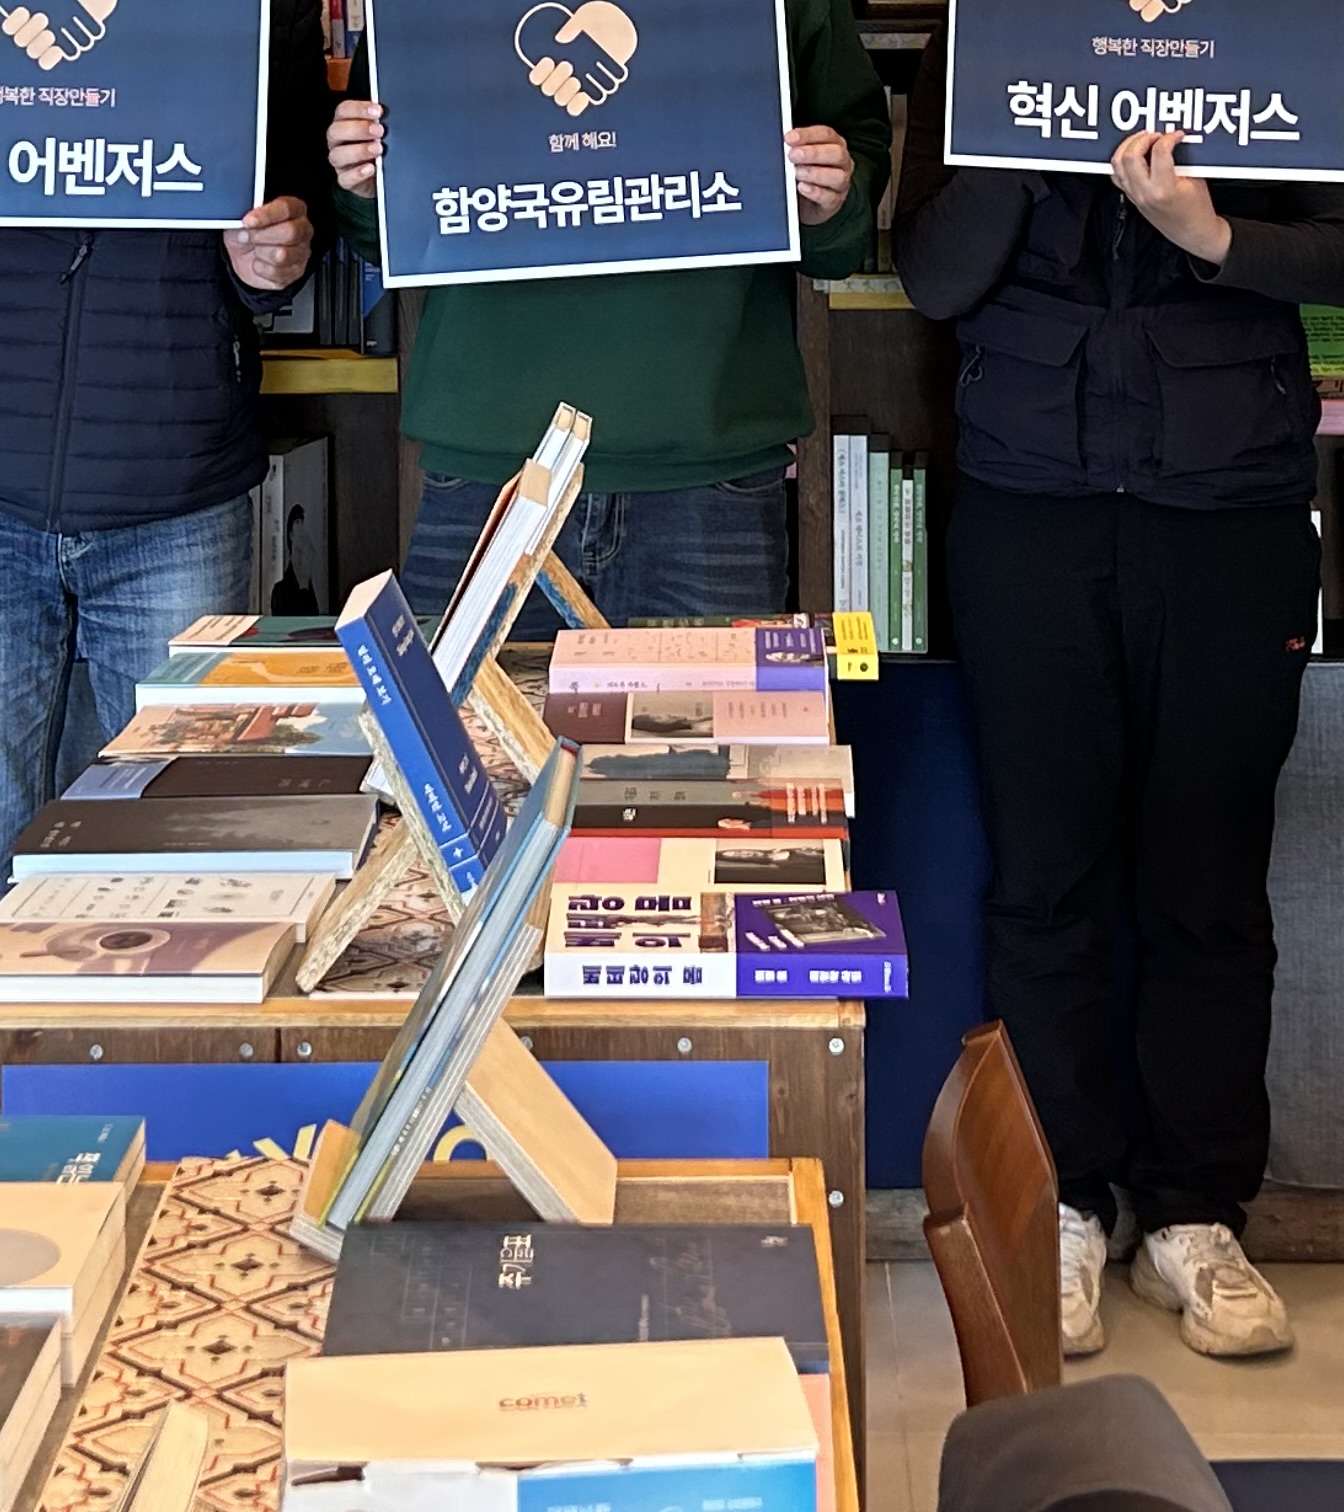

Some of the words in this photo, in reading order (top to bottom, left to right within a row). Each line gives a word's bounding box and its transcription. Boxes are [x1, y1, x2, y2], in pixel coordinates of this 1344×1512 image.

[1092, 37, 1137, 57] 행복한
[1140, 38, 1215, 58] 직장만들기
[38, 87, 116, 108] 직장만들기
[1007, 80, 1099, 140] 혁신
[1111, 87, 1301, 146] 어벤저스
[549, 132, 579, 152] 함께
[582, 131, 616, 150] 해요!
[8, 137, 204, 197] 어벤저스
[432, 171, 743, 235] 함양국유림관리소
[499, 1391, 588, 1410] comet
